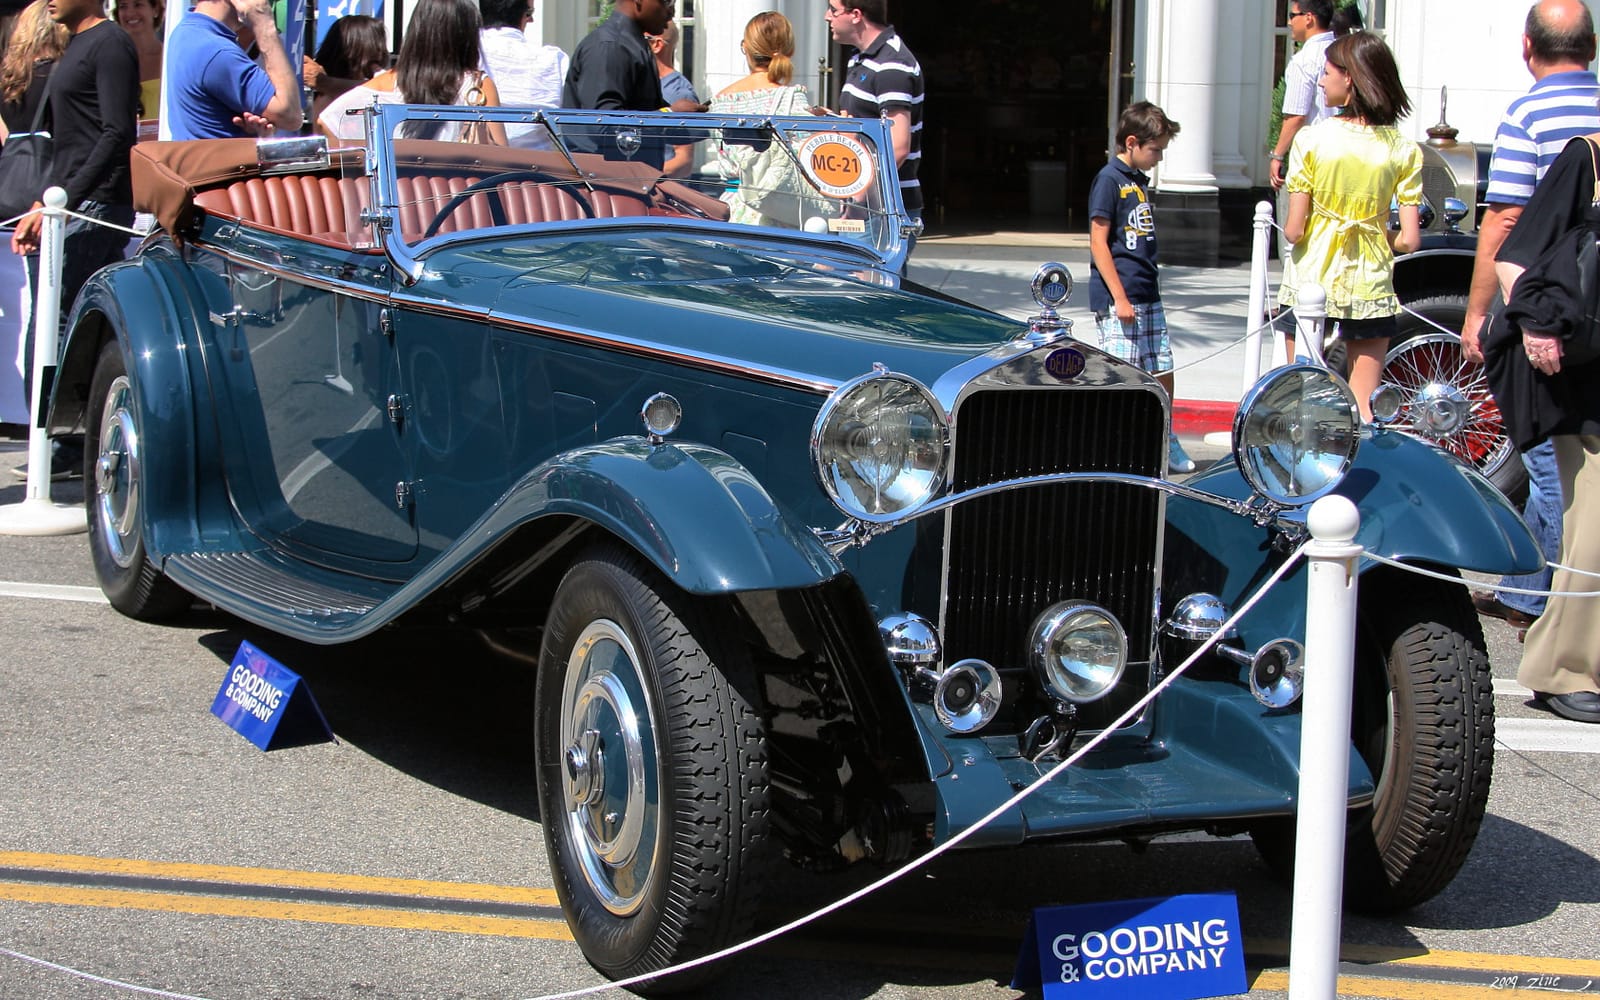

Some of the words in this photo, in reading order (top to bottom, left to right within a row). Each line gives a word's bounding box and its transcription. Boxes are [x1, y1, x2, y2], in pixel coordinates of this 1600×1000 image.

[806, 135, 835, 153] PEBBLE
[837, 135, 864, 157] BEACH
[812, 154, 859, 173] MC-21
[1049, 353, 1083, 375] DELAGE
[231, 665, 282, 709] GOODING
[1052, 918, 1229, 961] GOODING
[1060, 962, 1080, 984] &
[1085, 946, 1227, 981] COMPANY
